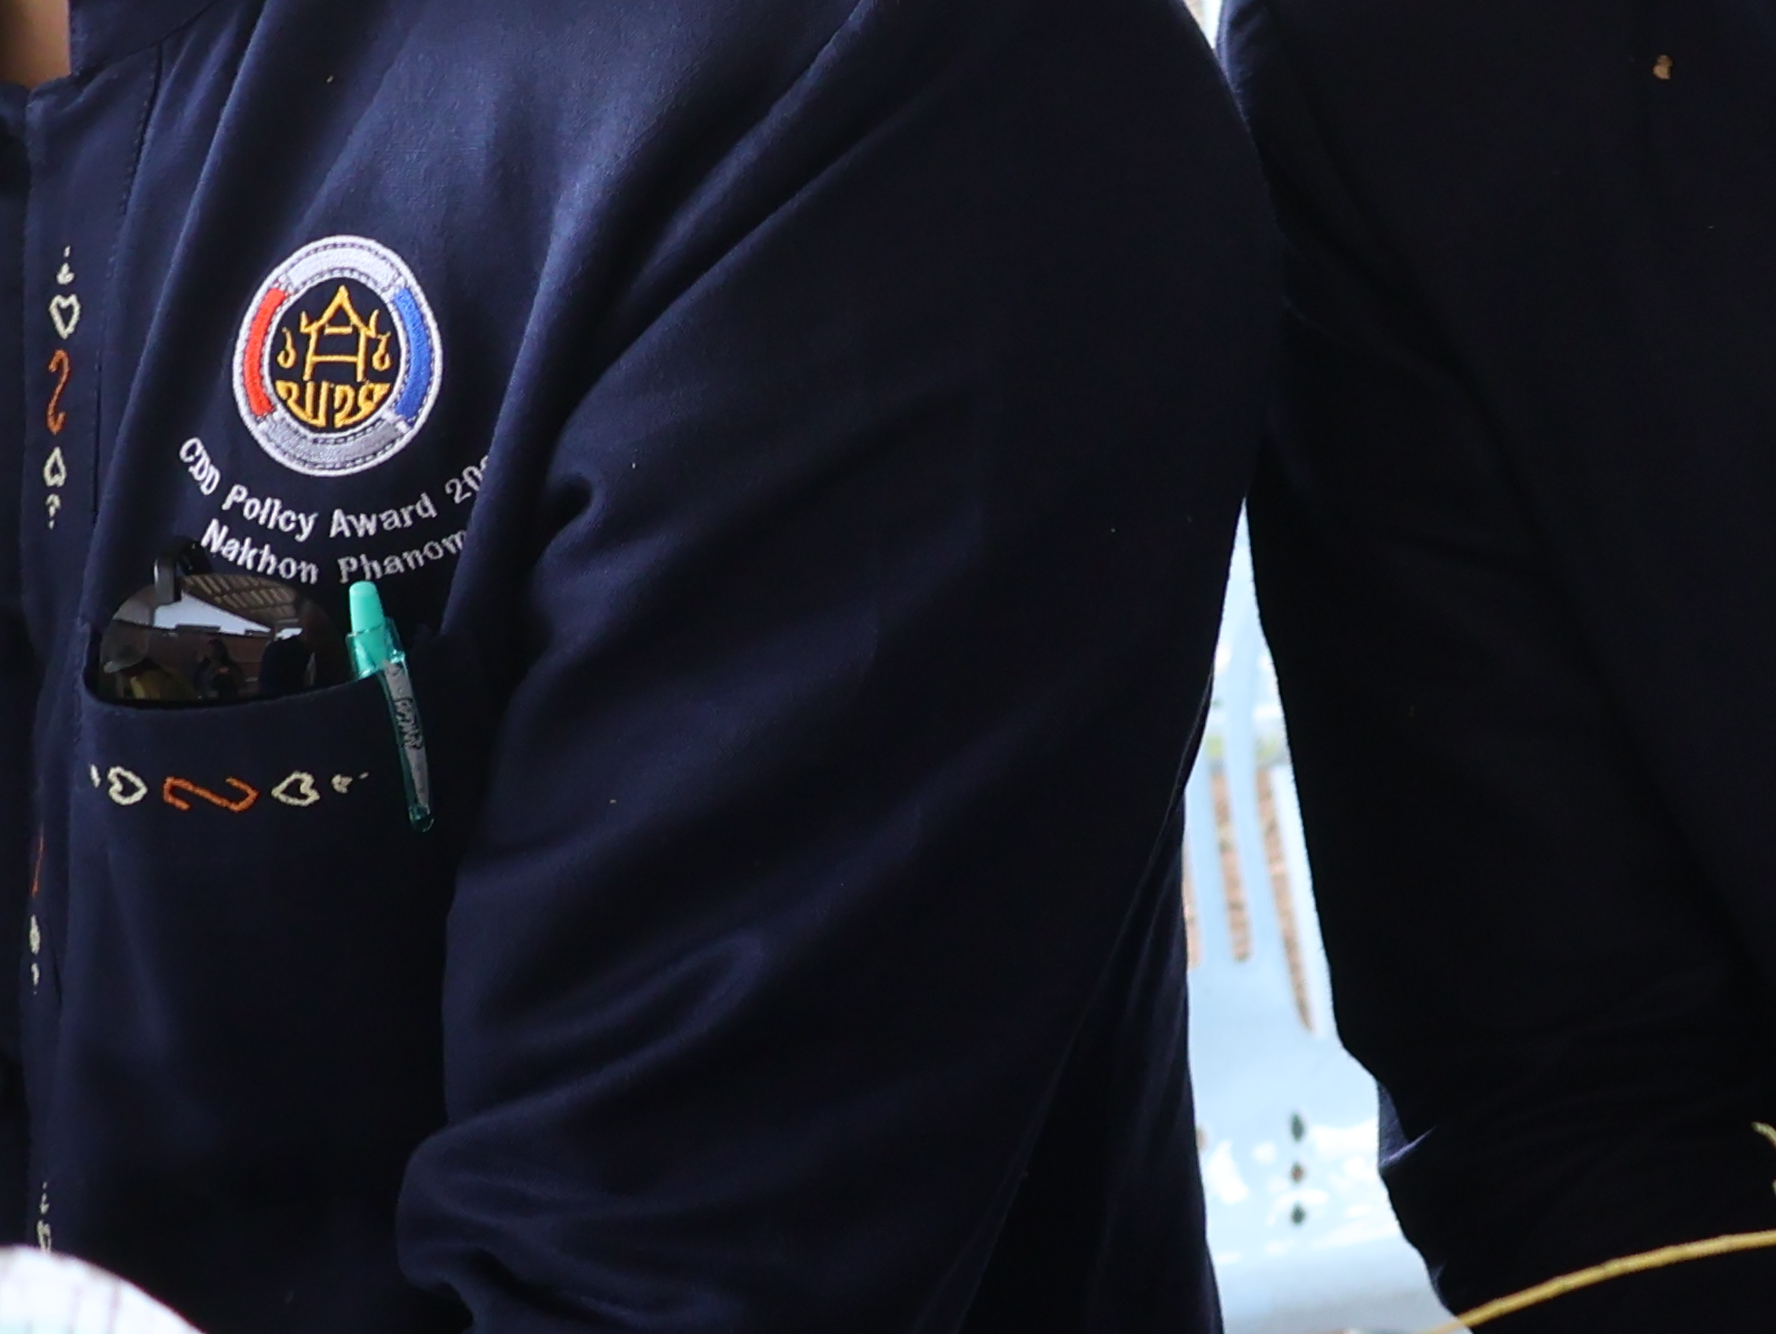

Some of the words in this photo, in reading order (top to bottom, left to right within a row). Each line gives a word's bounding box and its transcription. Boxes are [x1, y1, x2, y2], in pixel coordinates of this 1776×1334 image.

[178, 436, 219, 497] CDD
[223, 485, 318, 543] Policy
[328, 493, 435, 540] Award
[200, 519, 318, 585] Nakhon
